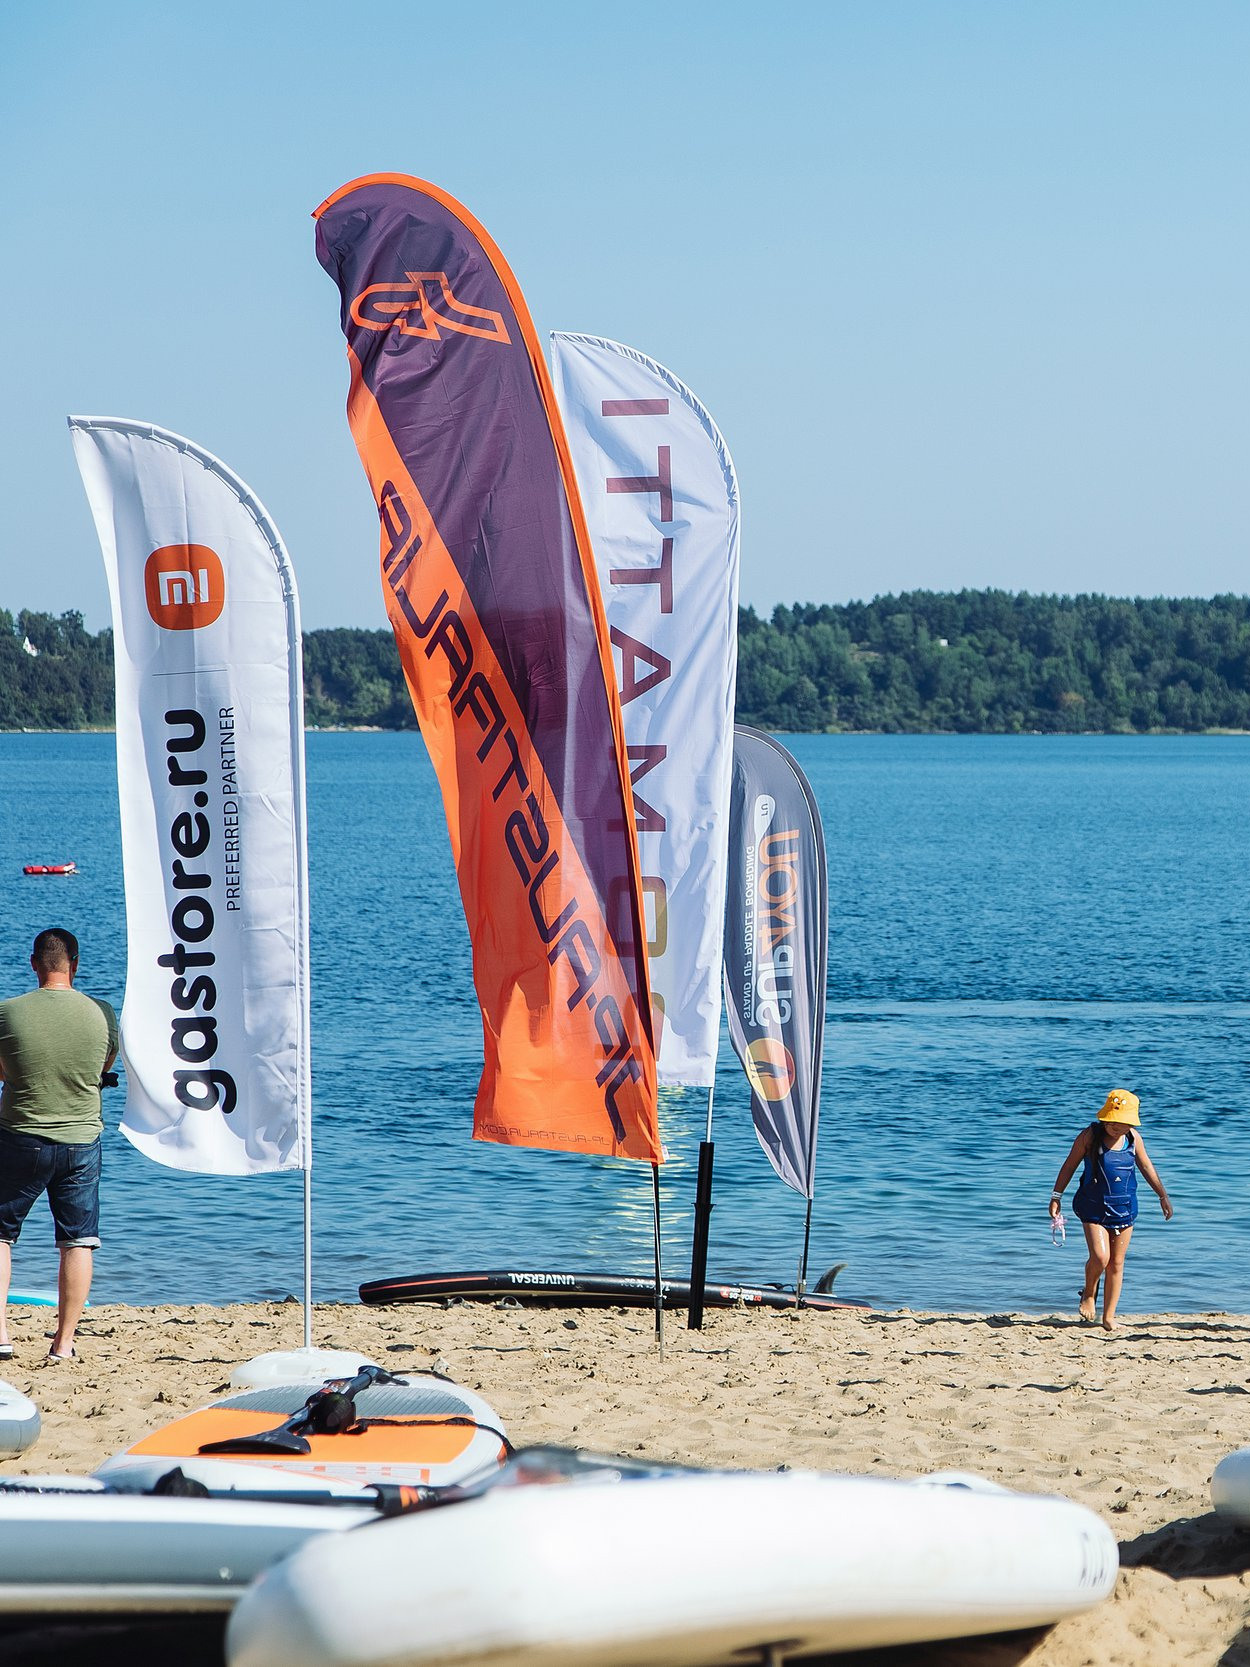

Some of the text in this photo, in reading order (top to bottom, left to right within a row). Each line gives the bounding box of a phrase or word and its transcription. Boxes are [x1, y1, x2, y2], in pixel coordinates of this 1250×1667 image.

[157, 707, 241, 1115] gastore.ru
[218, 706, 241, 912] PREFERRED PARTNER
[507, 1273, 576, 1286] UNIVERSAL
